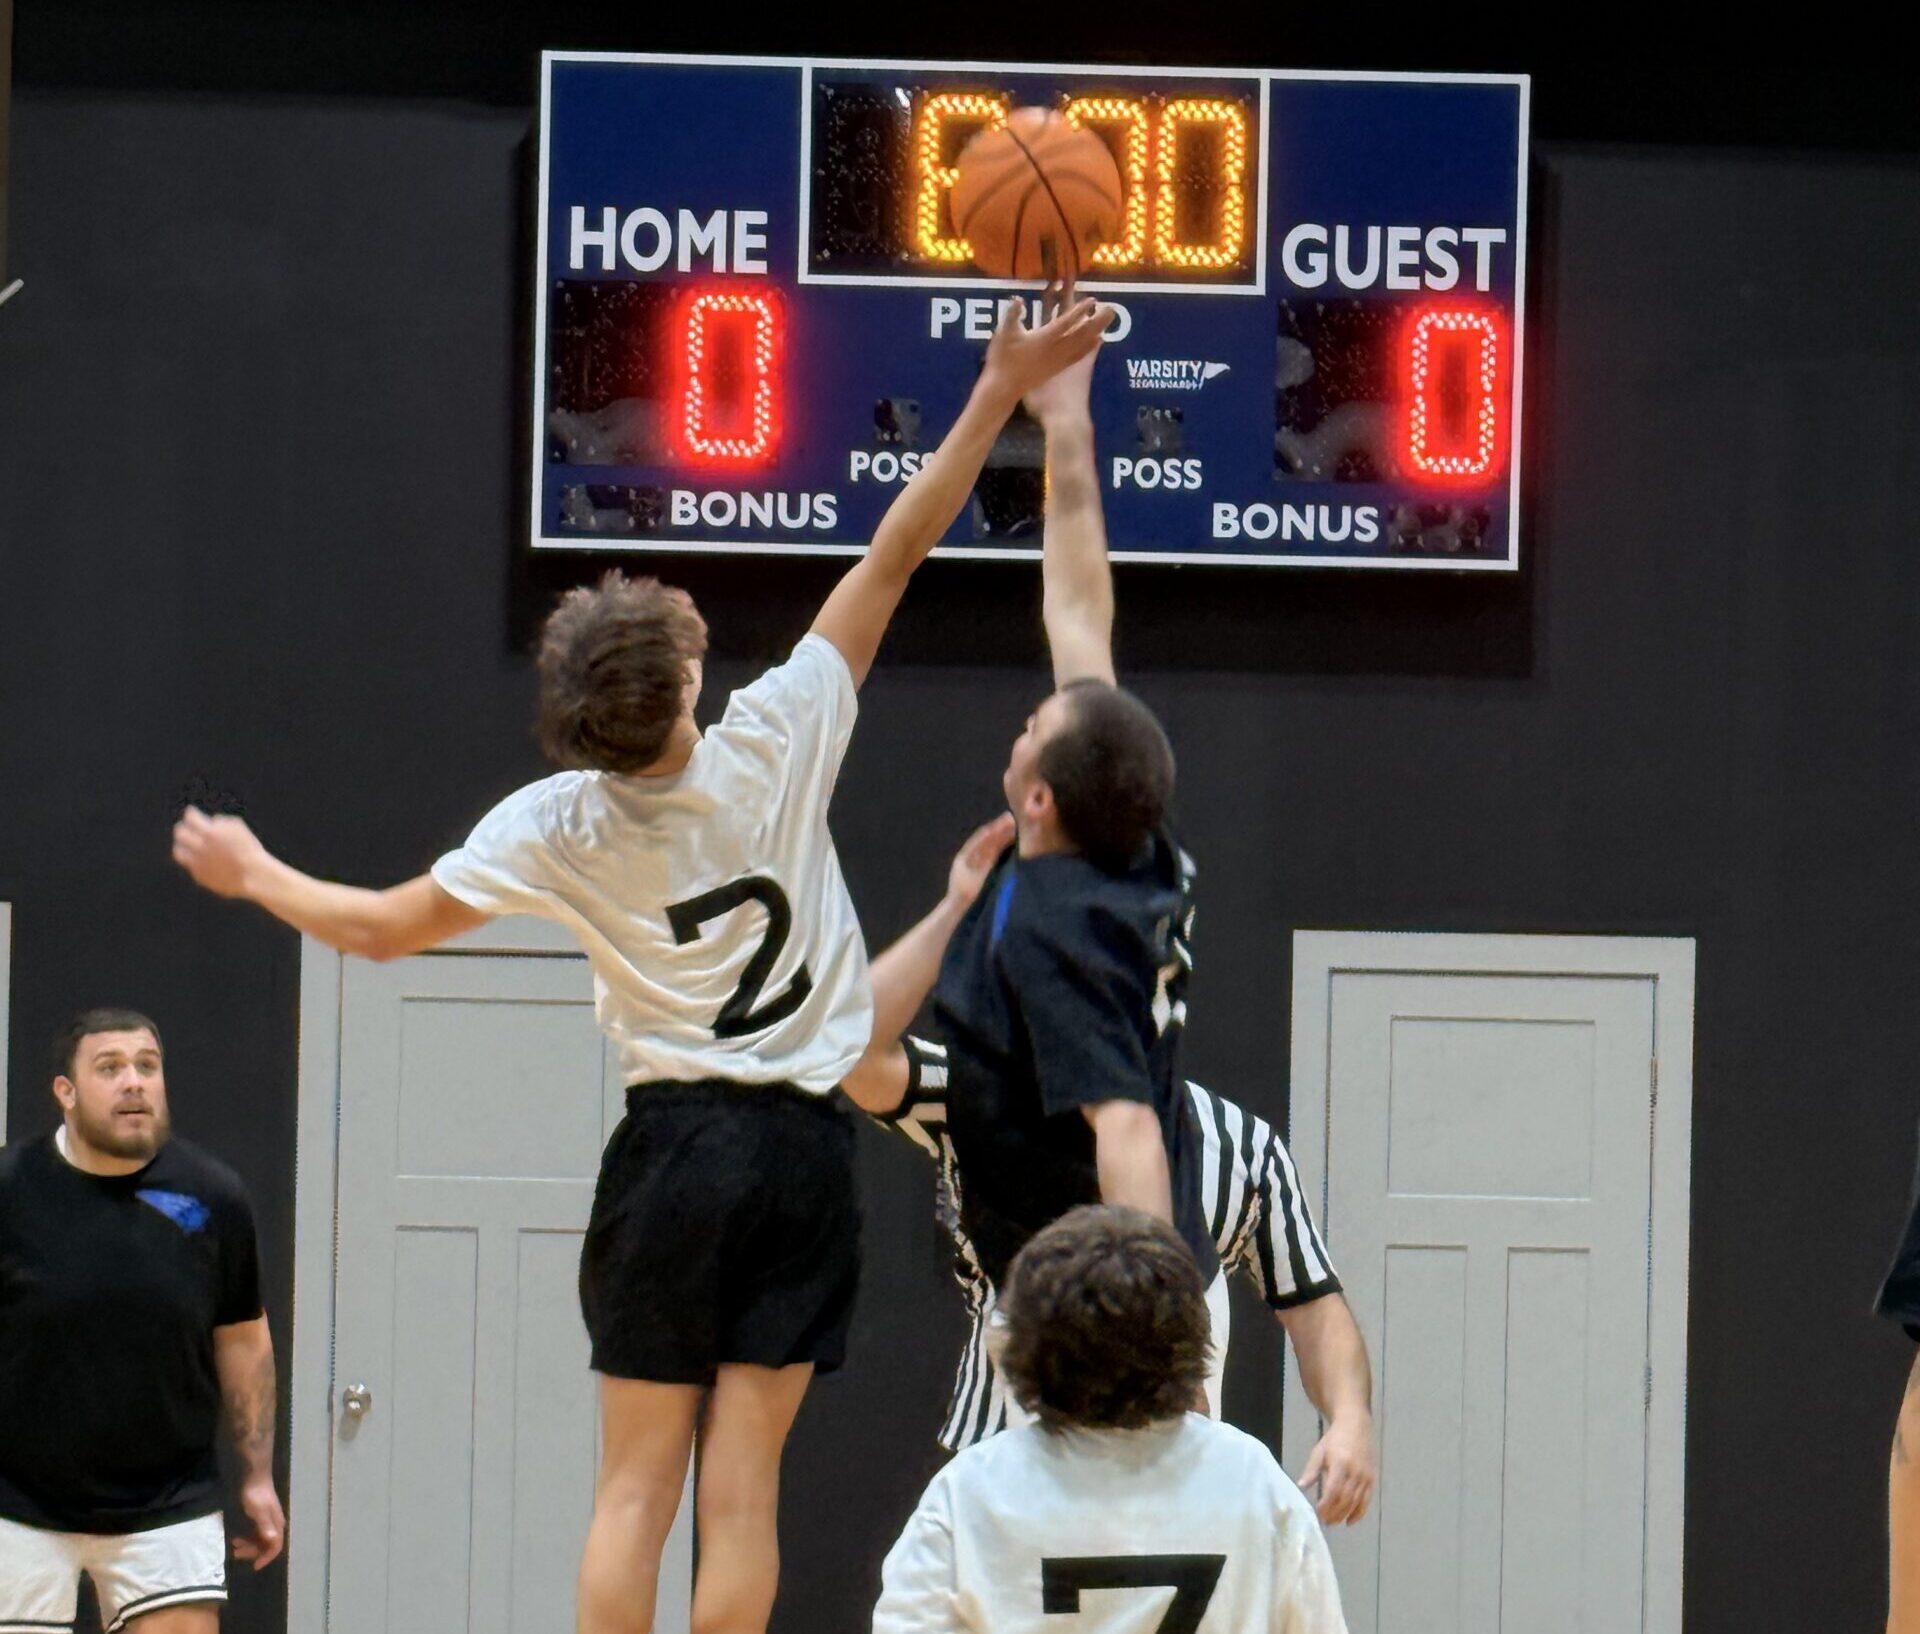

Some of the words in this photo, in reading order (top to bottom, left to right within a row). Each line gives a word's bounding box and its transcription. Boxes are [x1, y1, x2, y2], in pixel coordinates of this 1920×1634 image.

[569, 206, 768, 275] HOME
[1281, 223, 1507, 292] GUEST
[686, 294, 774, 459] 0
[1126, 358, 1203, 380] VARSITY
[1410, 311, 1498, 476] 0
[1112, 456, 1203, 490] POSS
[671, 489, 838, 529] BONUS
[1211, 502, 1380, 543] BONUS
[664, 875, 813, 1040] 2
[1040, 1553, 1228, 1634] 7
